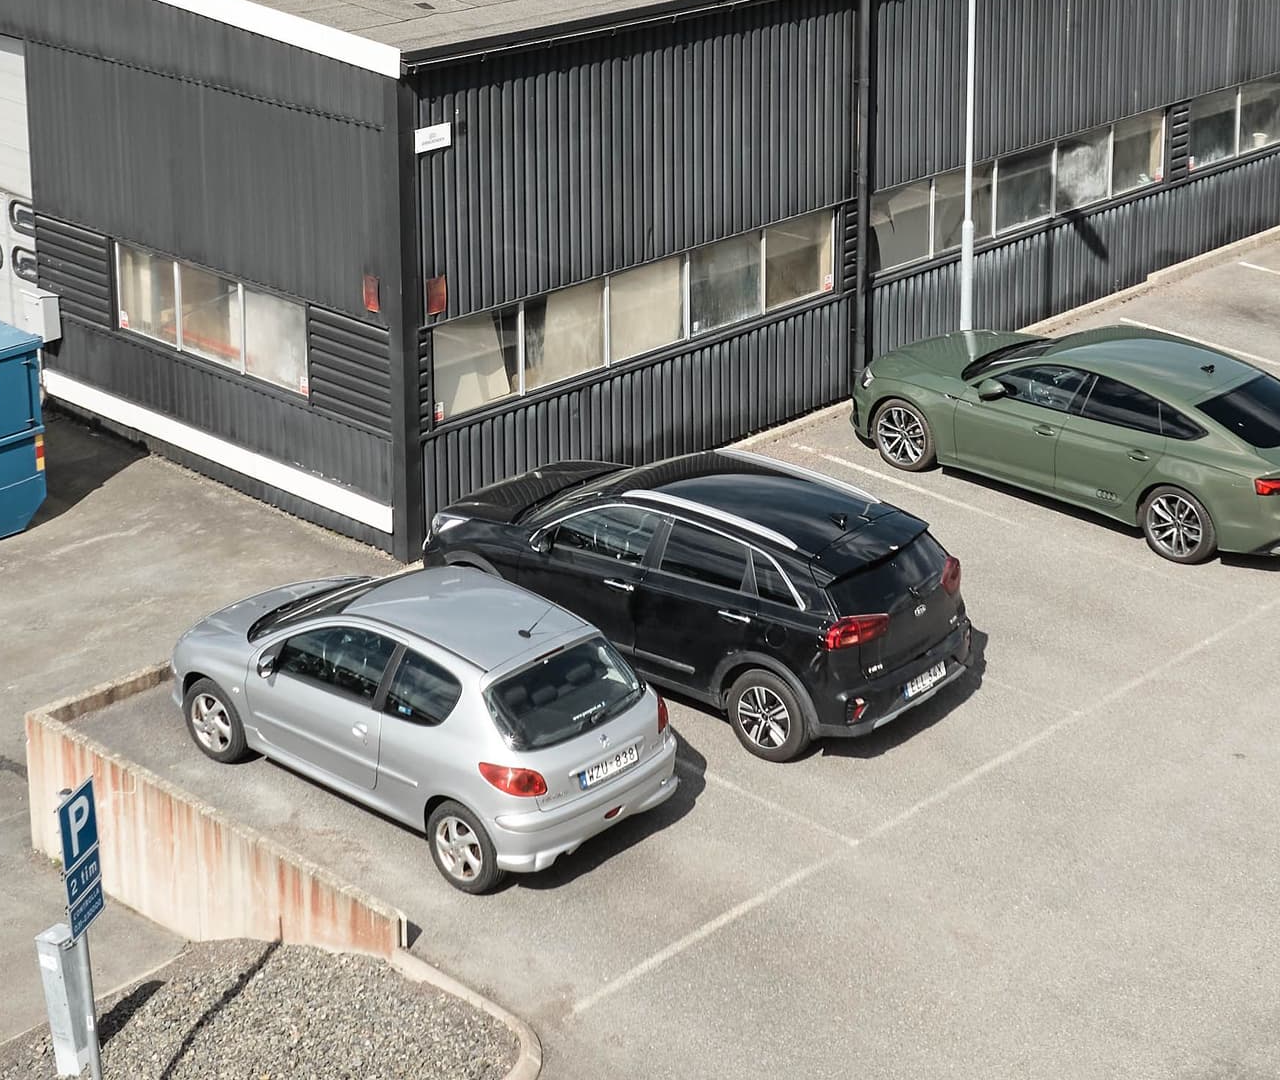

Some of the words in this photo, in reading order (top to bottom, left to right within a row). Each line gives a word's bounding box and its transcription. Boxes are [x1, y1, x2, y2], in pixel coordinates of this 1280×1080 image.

[587, 760, 608, 782] WZU
[615, 747, 635, 768] 838
[68, 795, 90, 858] P
[70, 878, 78, 896] 2
[81, 860, 97, 885] tim
